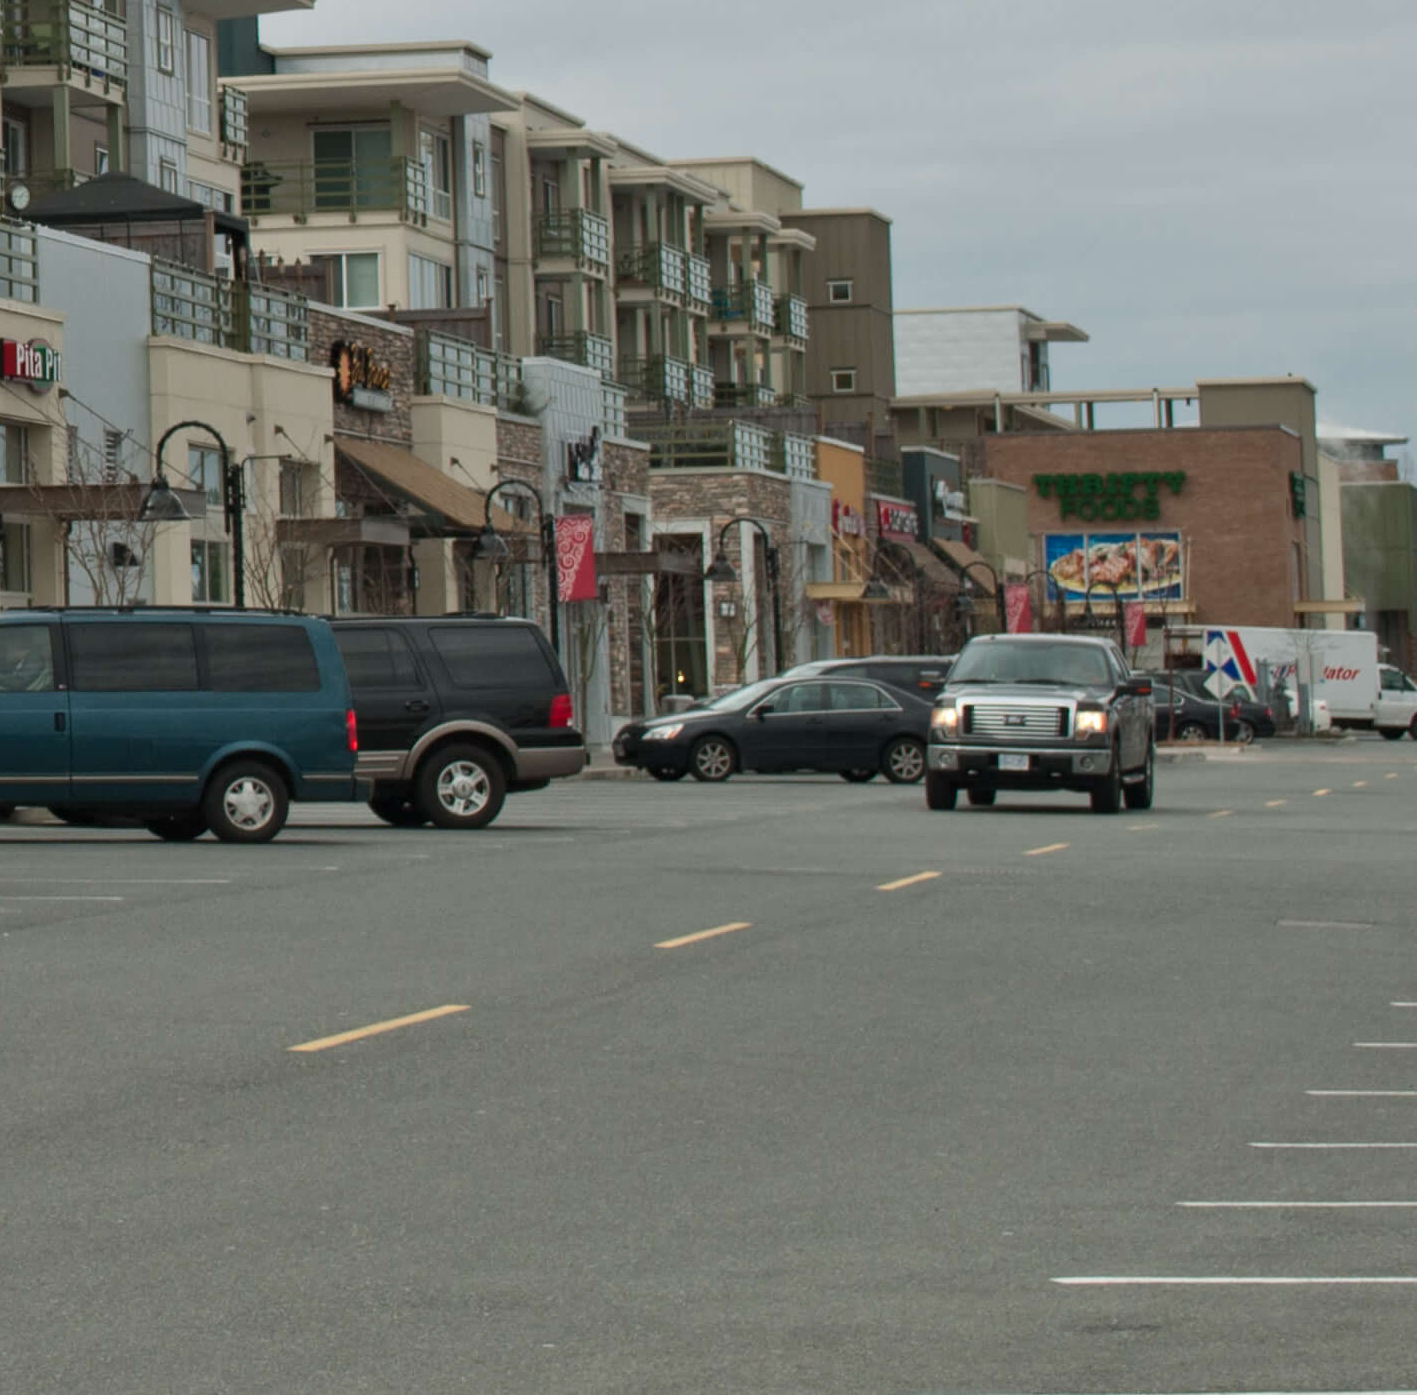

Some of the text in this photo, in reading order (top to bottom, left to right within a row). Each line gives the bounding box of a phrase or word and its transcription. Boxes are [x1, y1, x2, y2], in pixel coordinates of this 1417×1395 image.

[16, 341, 62, 380] Pita Pit
[1033, 471, 1186, 497] THRIFTY
[1060, 496, 1161, 521] FOODS
